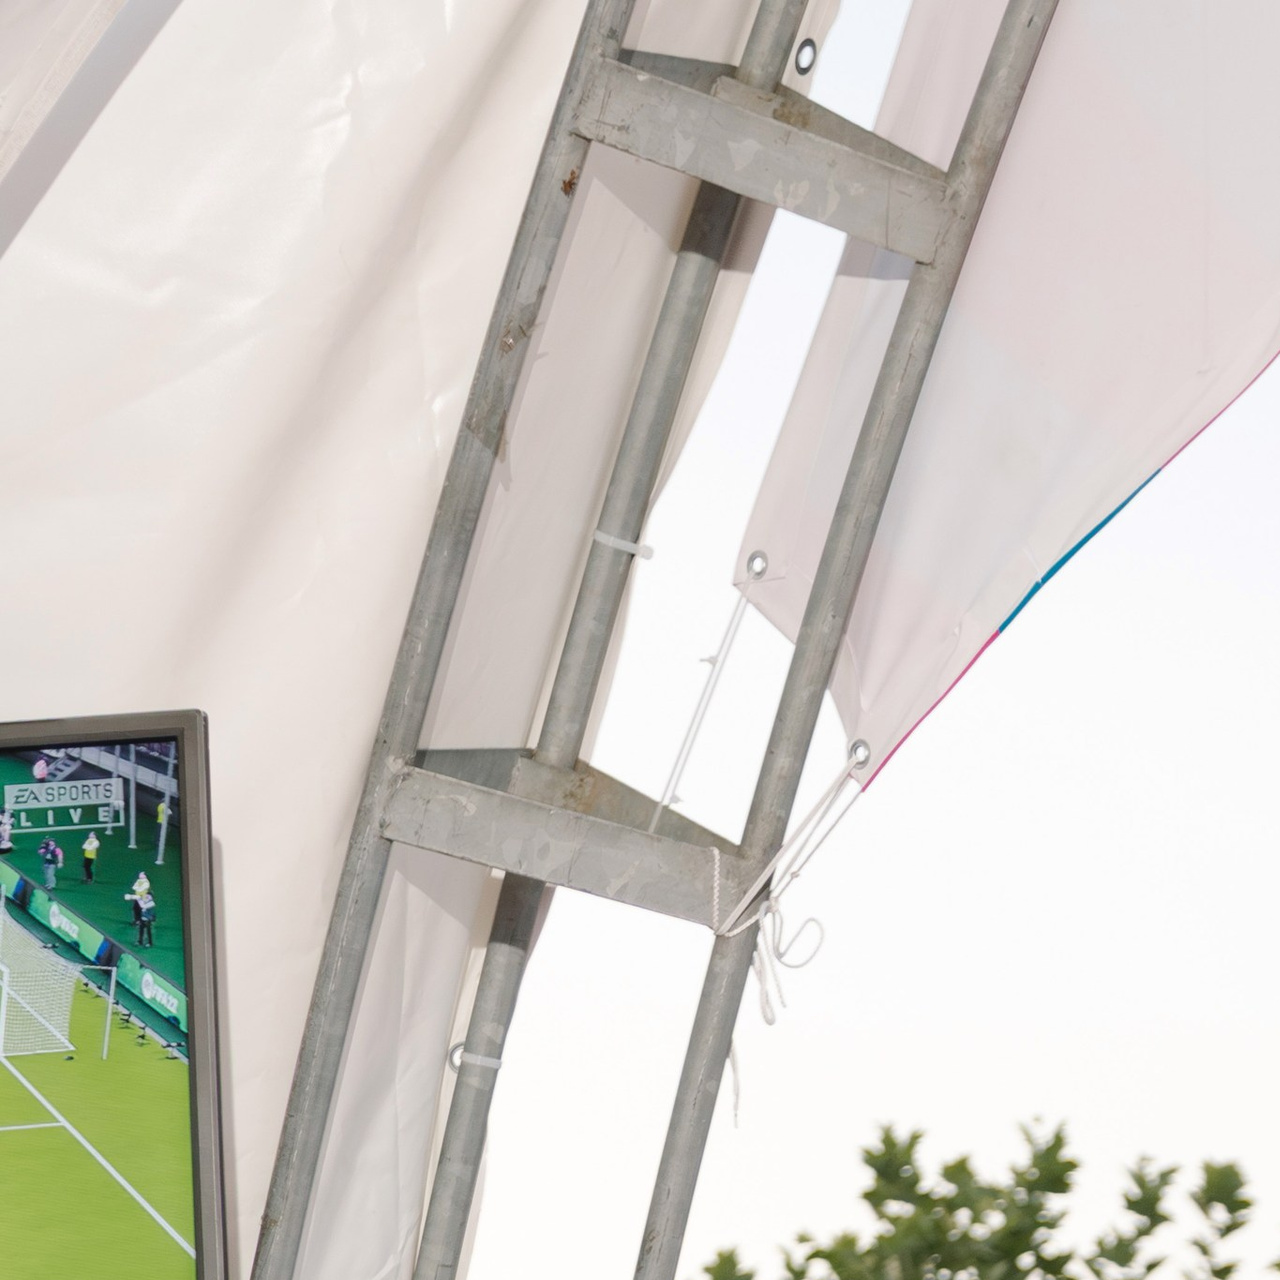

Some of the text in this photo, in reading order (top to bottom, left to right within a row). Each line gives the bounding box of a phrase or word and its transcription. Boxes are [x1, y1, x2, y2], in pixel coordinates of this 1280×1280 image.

[13, 783, 113, 804] EA SPORTS
[20, 806, 110, 827] LIVE
